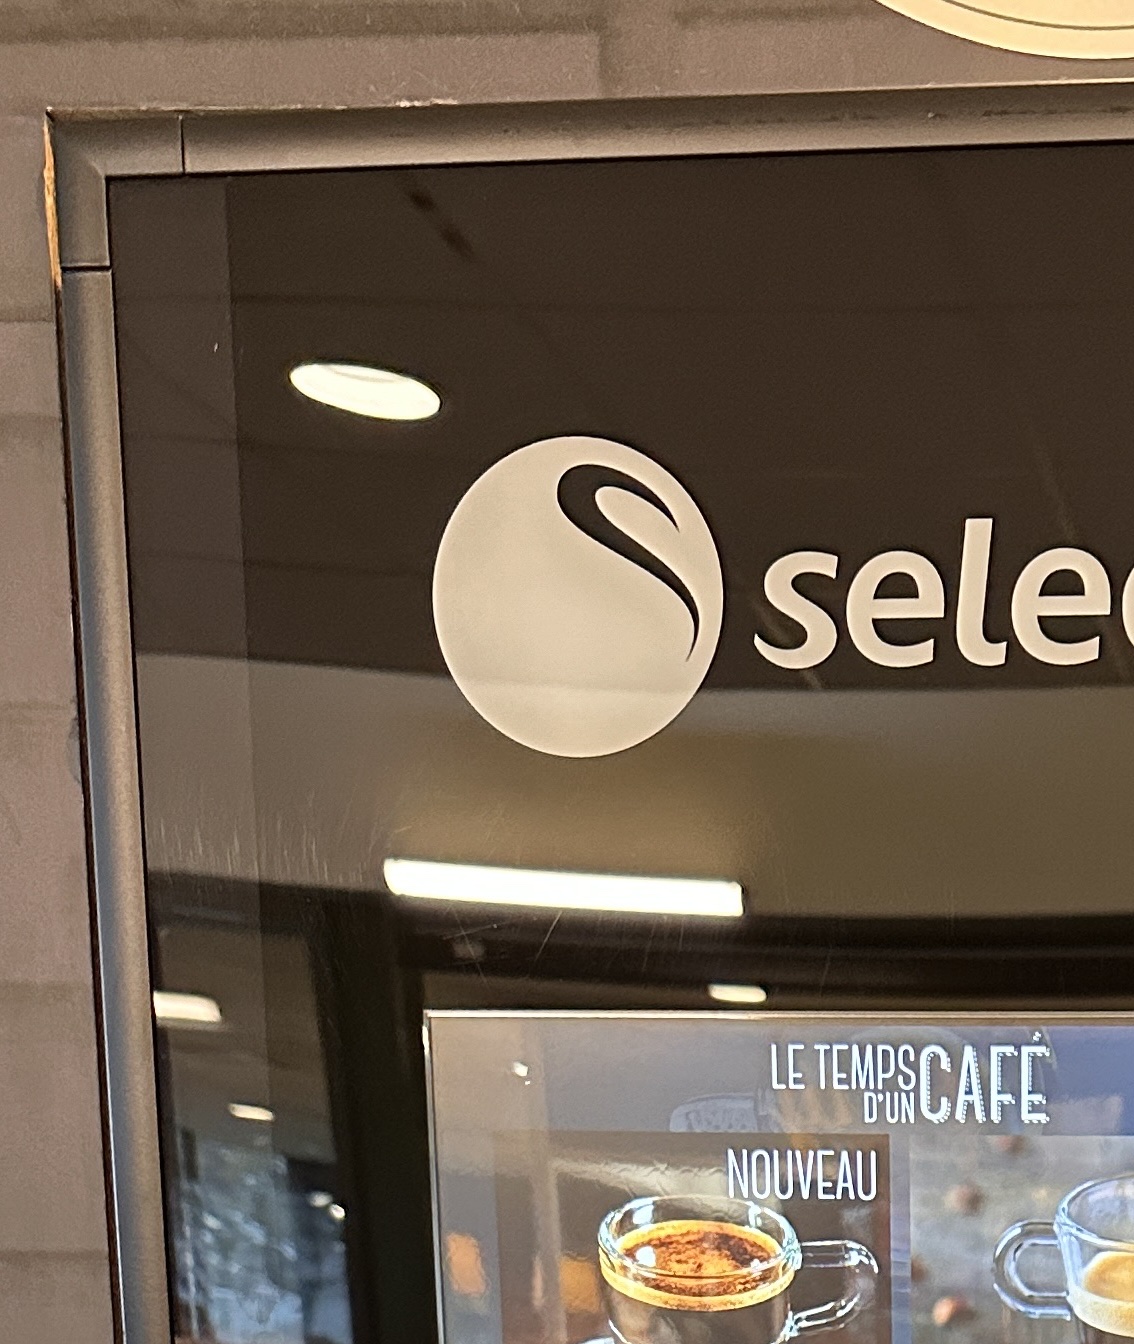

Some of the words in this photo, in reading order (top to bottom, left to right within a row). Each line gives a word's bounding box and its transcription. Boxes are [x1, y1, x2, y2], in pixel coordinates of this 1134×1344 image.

[771, 1044, 803, 1090] LE
[814, 1044, 917, 1091] TEMPS
[864, 1091, 915, 1124] D'UN
[919, 1031, 1051, 1124] CAFÉ
[726, 1148, 878, 1201] NOUVEAU
